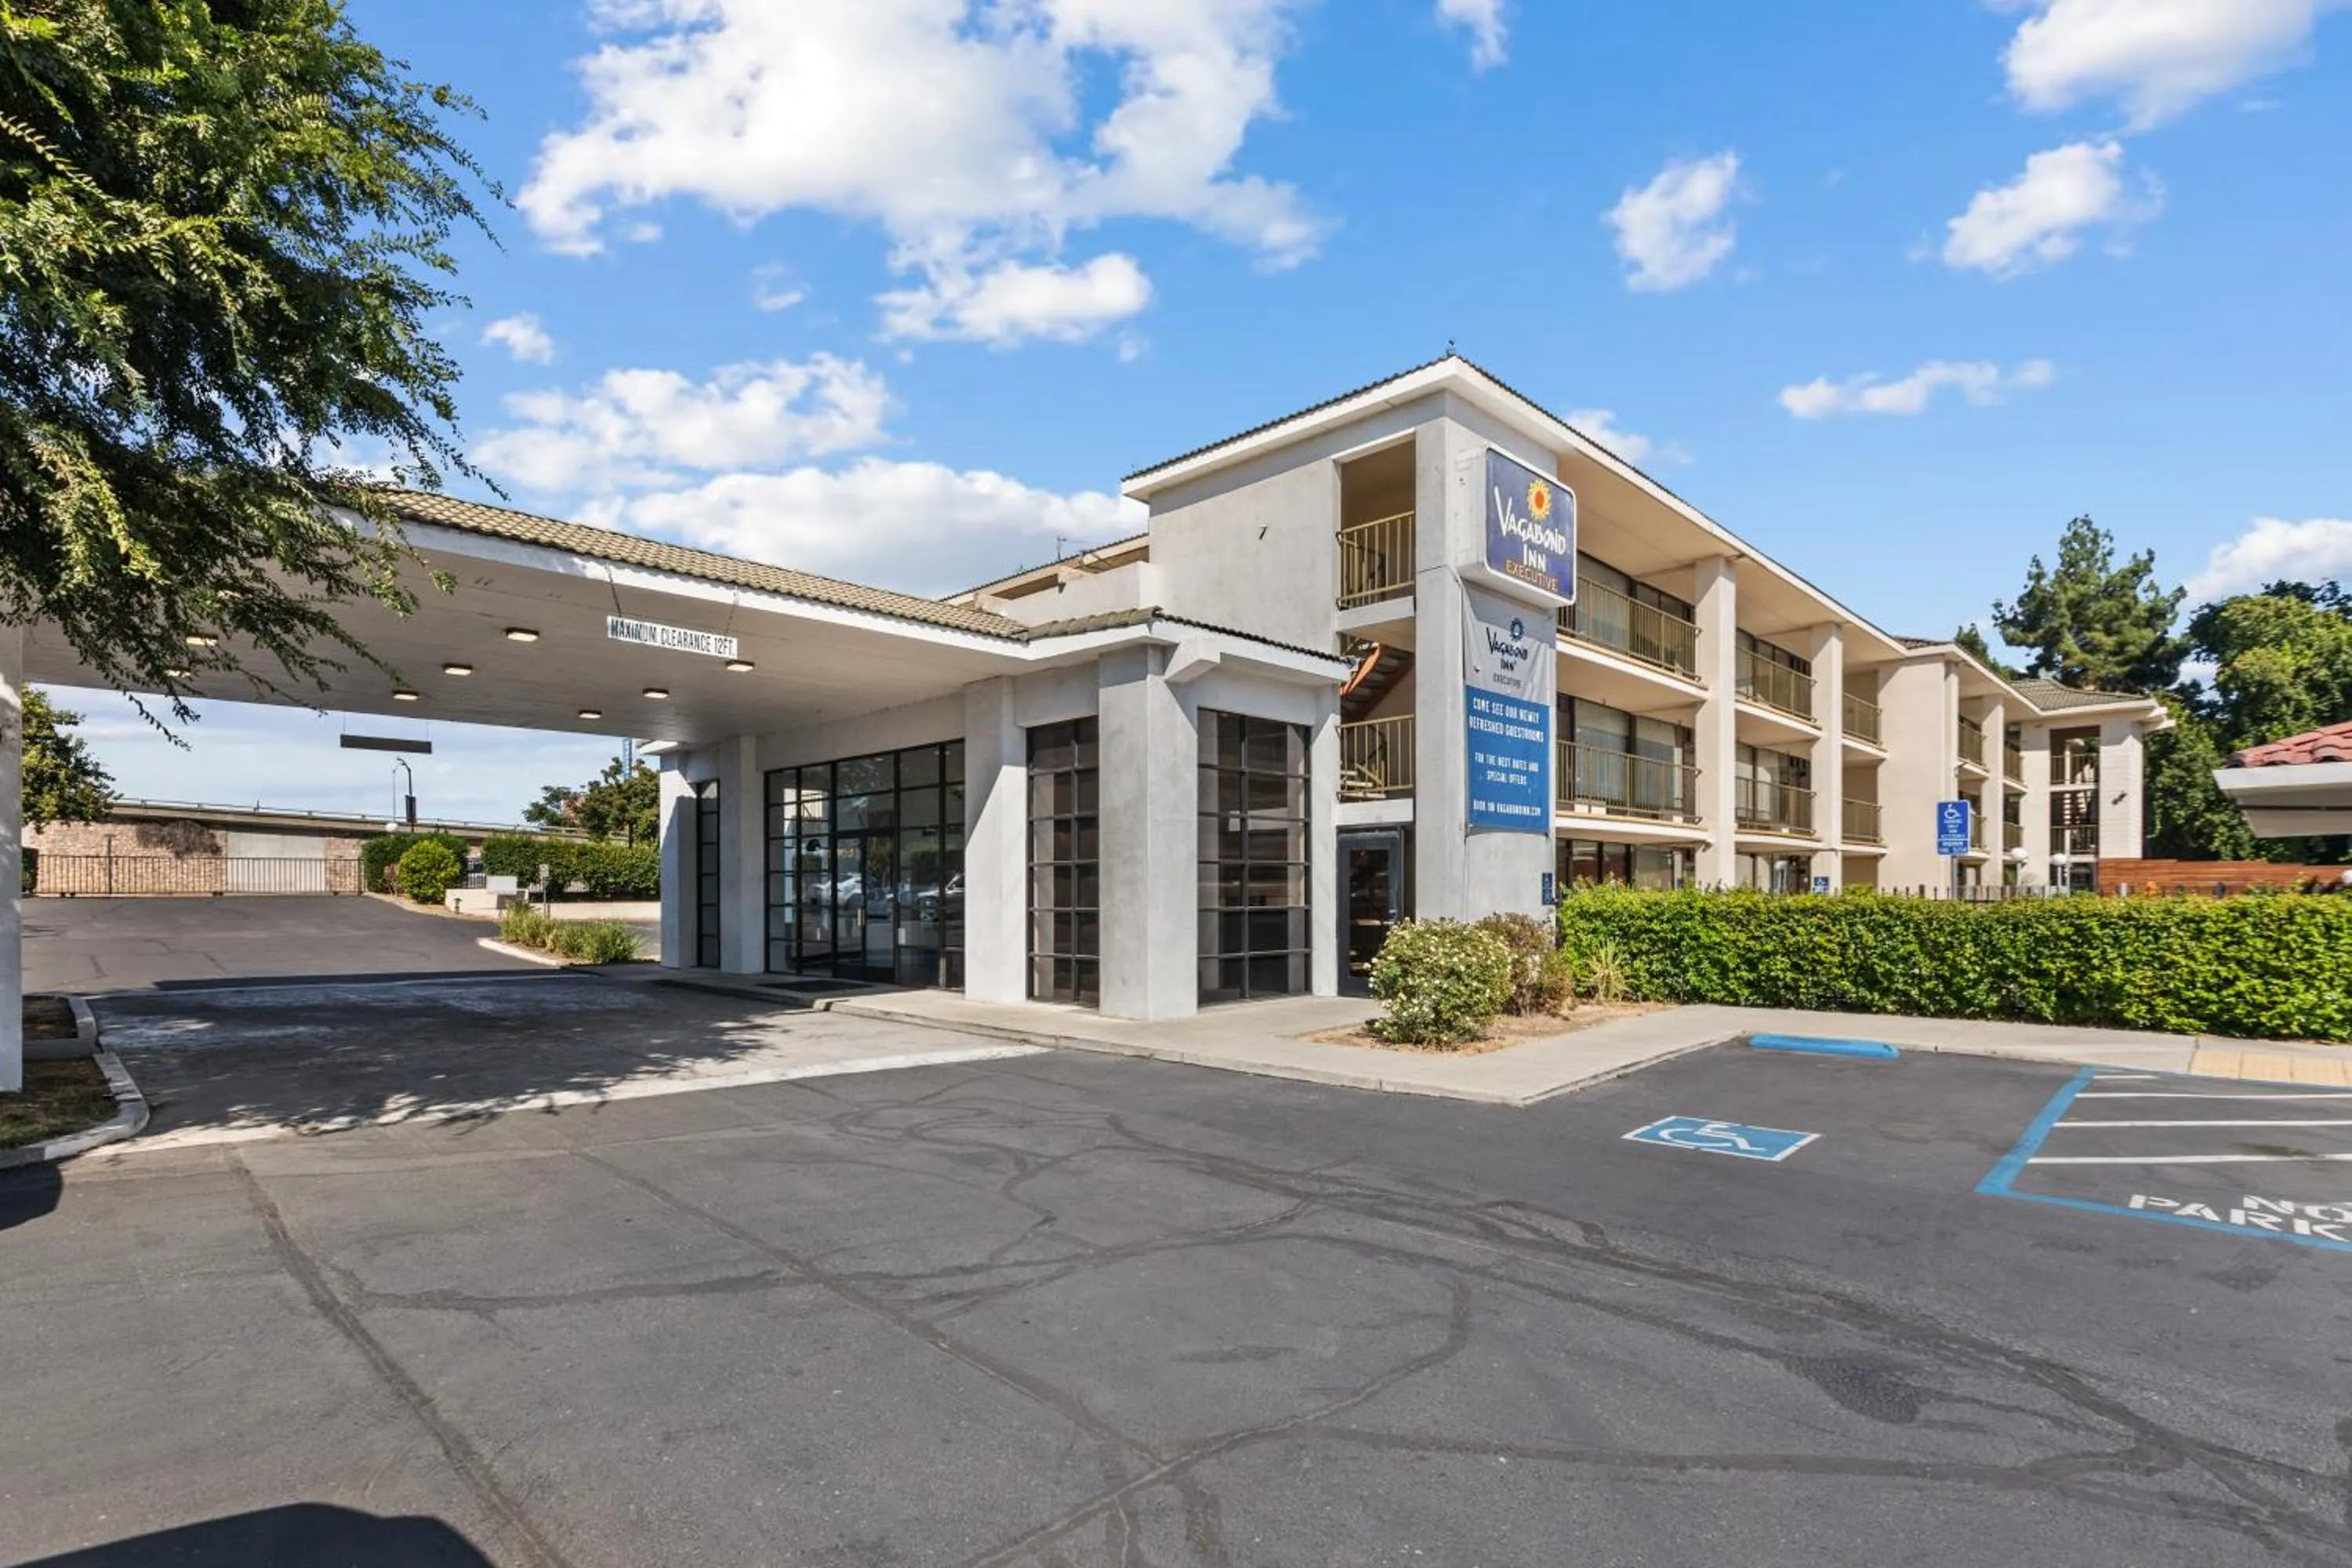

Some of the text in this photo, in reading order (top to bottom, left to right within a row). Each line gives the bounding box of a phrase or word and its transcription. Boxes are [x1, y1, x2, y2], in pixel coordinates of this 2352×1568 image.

[1494, 486, 1566, 555] VAGABOND
[1523, 543, 1546, 572] INN
[1505, 559, 1559, 592] EXECUTIVE
[660, 627, 711, 653] CLEARANCE
[1486, 626, 1528, 661] VAGABOND
[1501, 659, 1515, 671] INN
[1473, 697, 1539, 724] COME SEE OUR NEWLY
[1468, 714, 1544, 743] REFRESHED GUESTROOMS
[2128, 1193, 2351, 1243] PARK
[2243, 1194, 2352, 1223] NO
